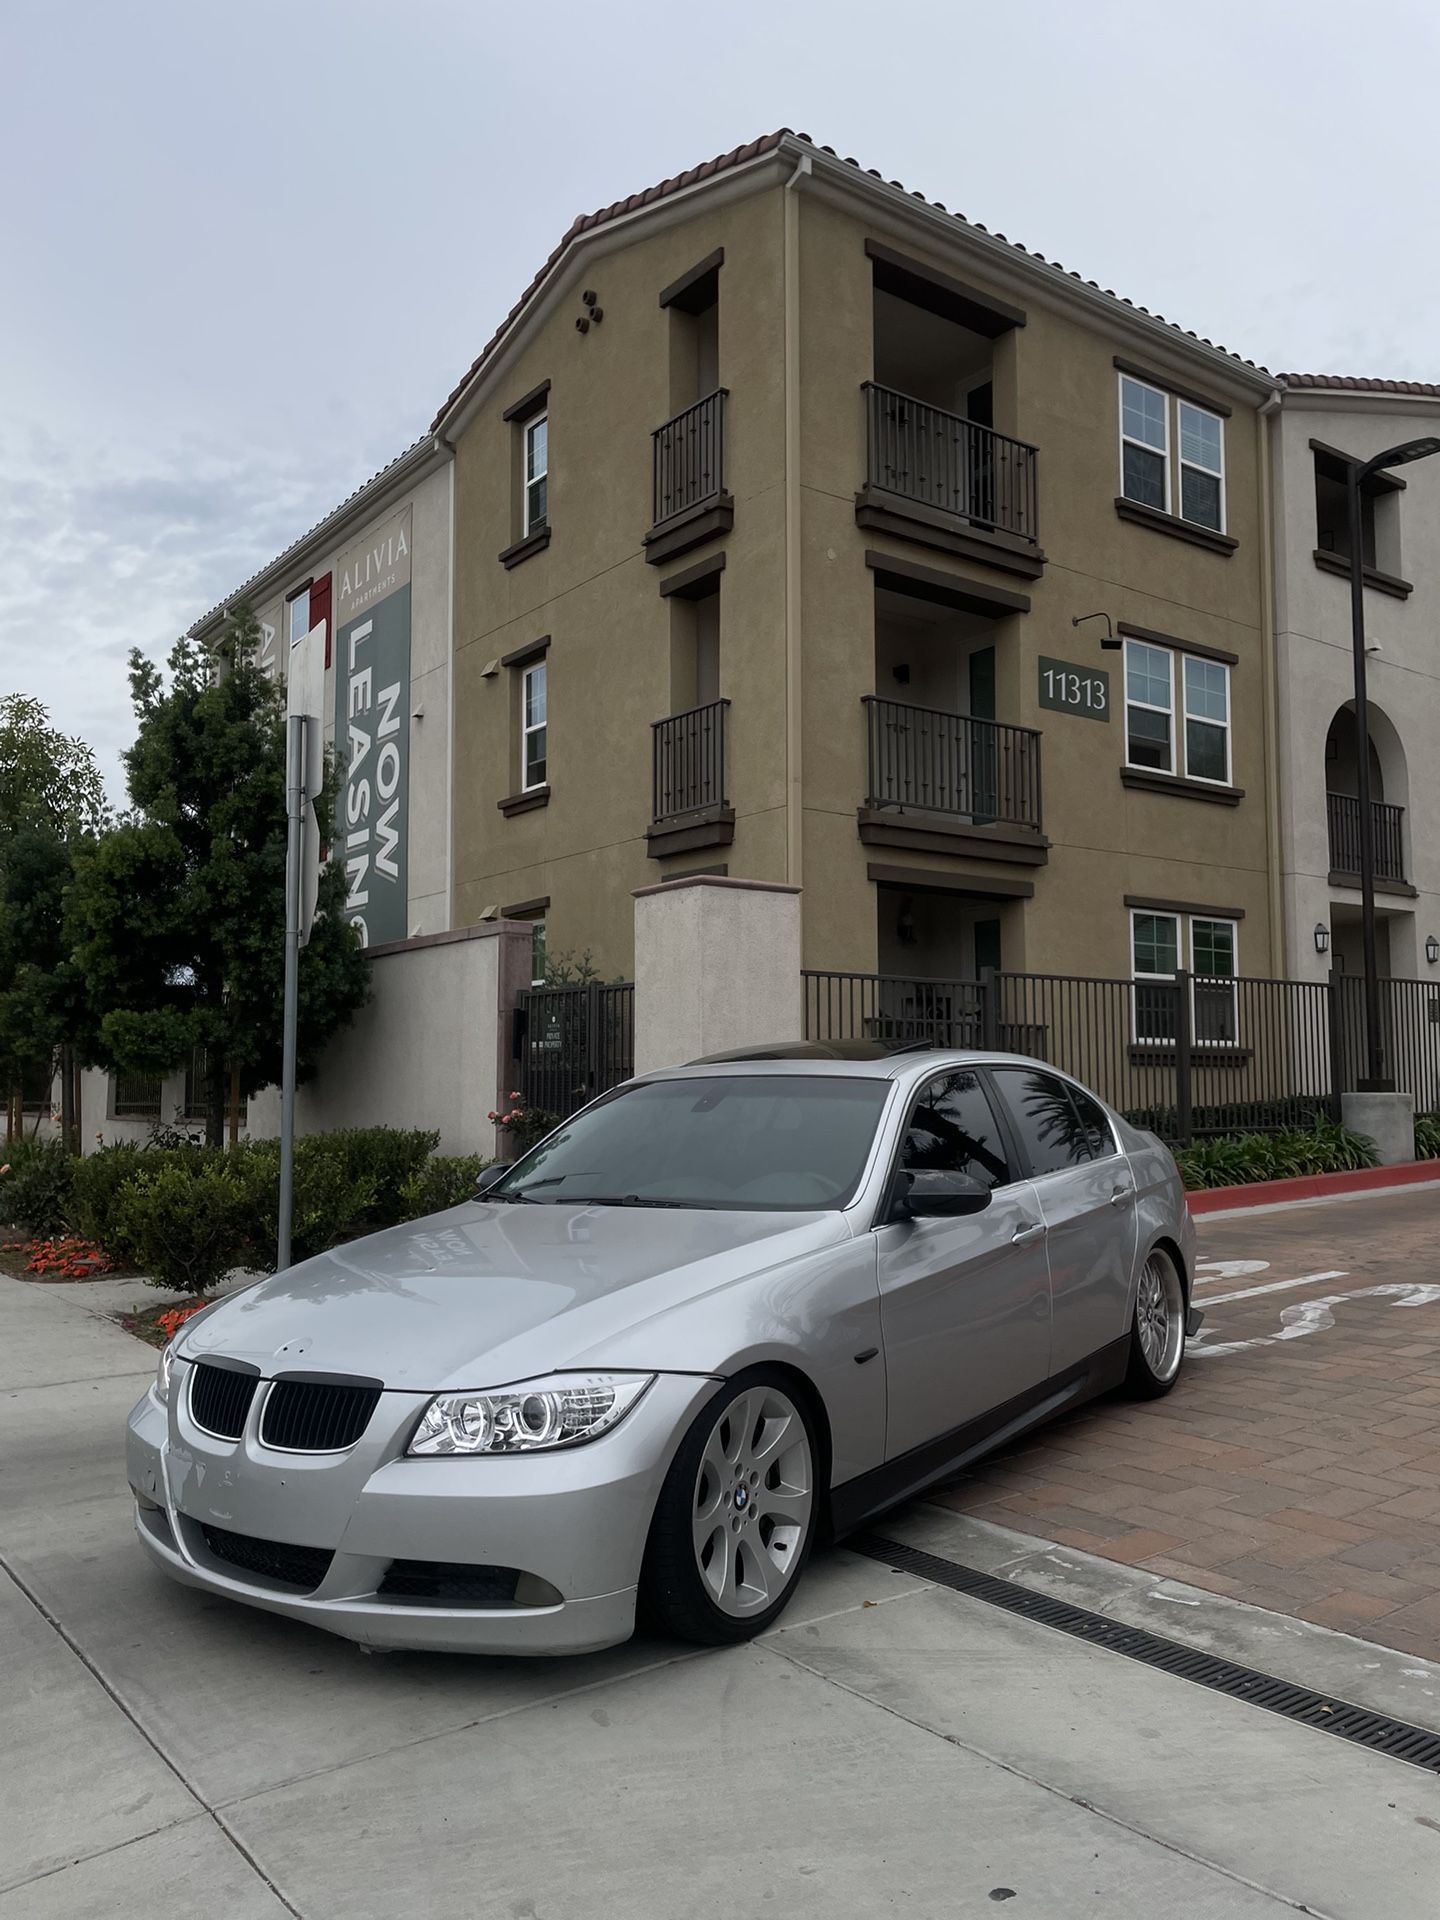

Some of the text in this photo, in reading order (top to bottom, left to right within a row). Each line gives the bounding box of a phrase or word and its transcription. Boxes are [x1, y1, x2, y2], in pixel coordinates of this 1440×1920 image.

[341, 529, 408, 600] ALIVIA
[351, 573, 396, 610] APARTMENTS
[1043, 669, 1106, 710] 11313
[375, 681, 400, 879] NOW
